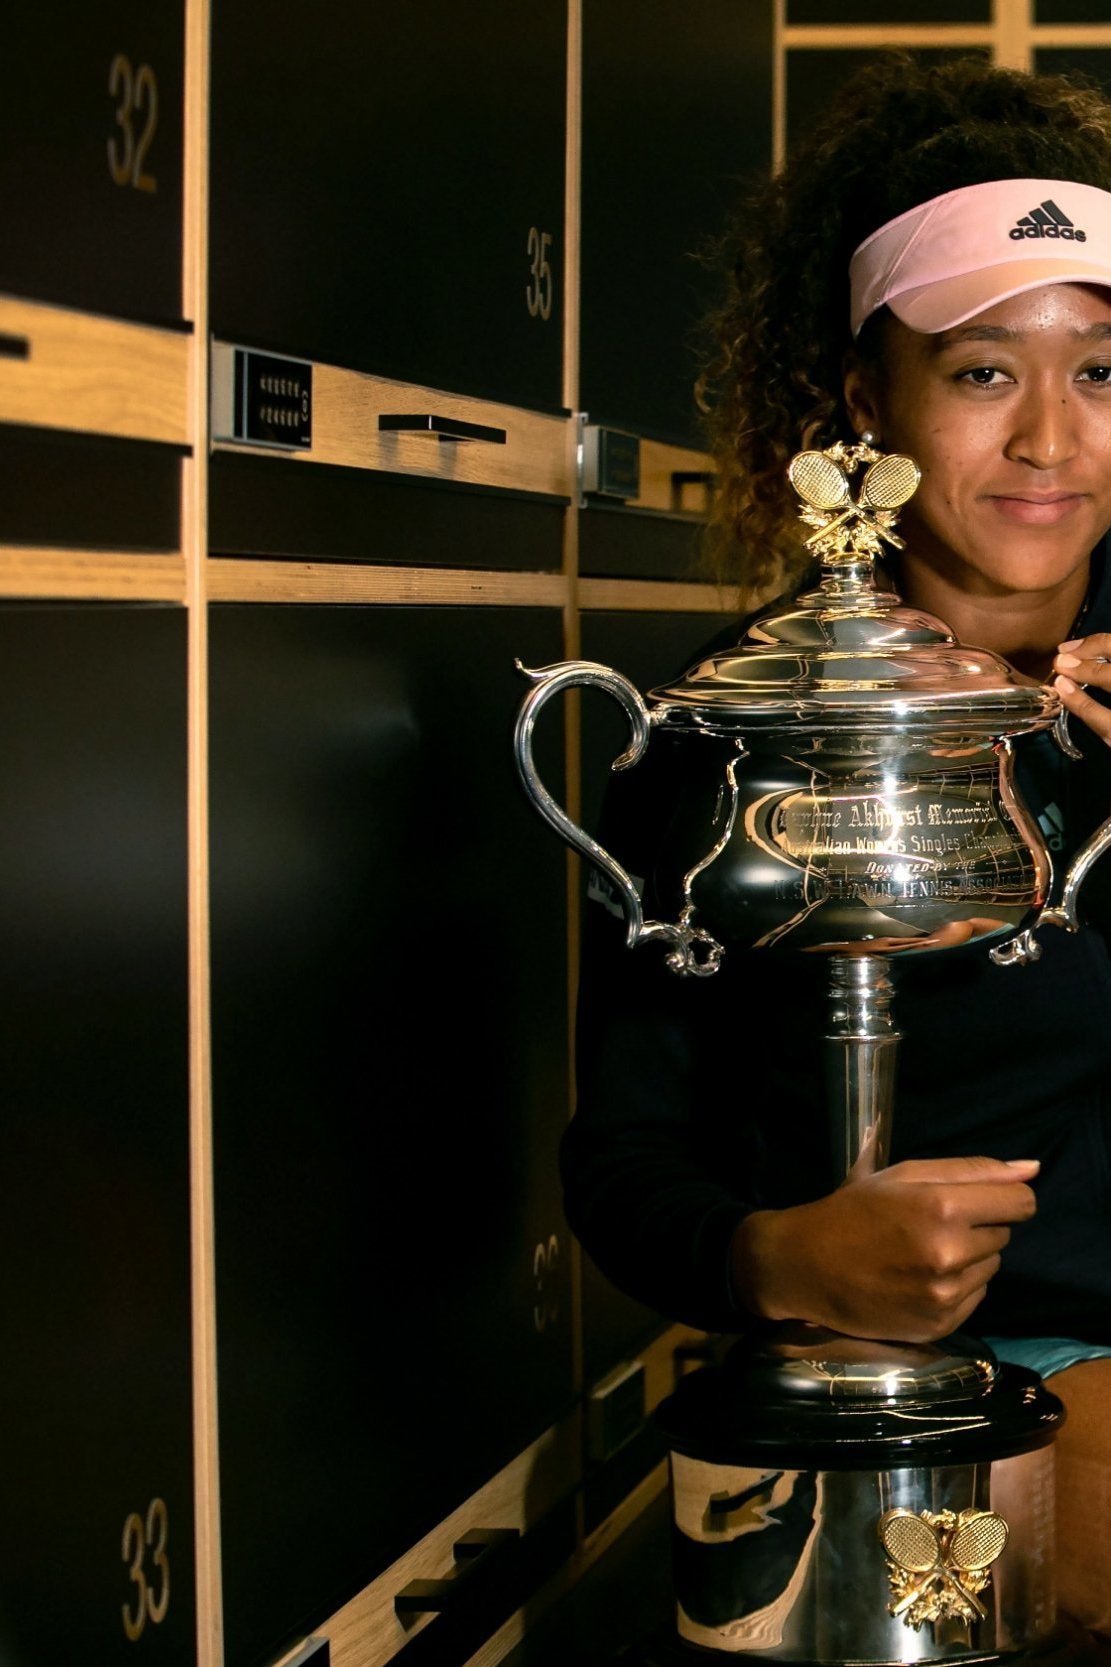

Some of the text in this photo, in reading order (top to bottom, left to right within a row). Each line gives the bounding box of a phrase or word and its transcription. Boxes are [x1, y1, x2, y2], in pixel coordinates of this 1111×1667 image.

[107, 53, 158, 194] 32
[526, 226, 553, 321] 35
[1009, 222, 1087, 242] adidas
[911, 833, 960, 857] Singles
[122, 1497, 170, 1642] 33
